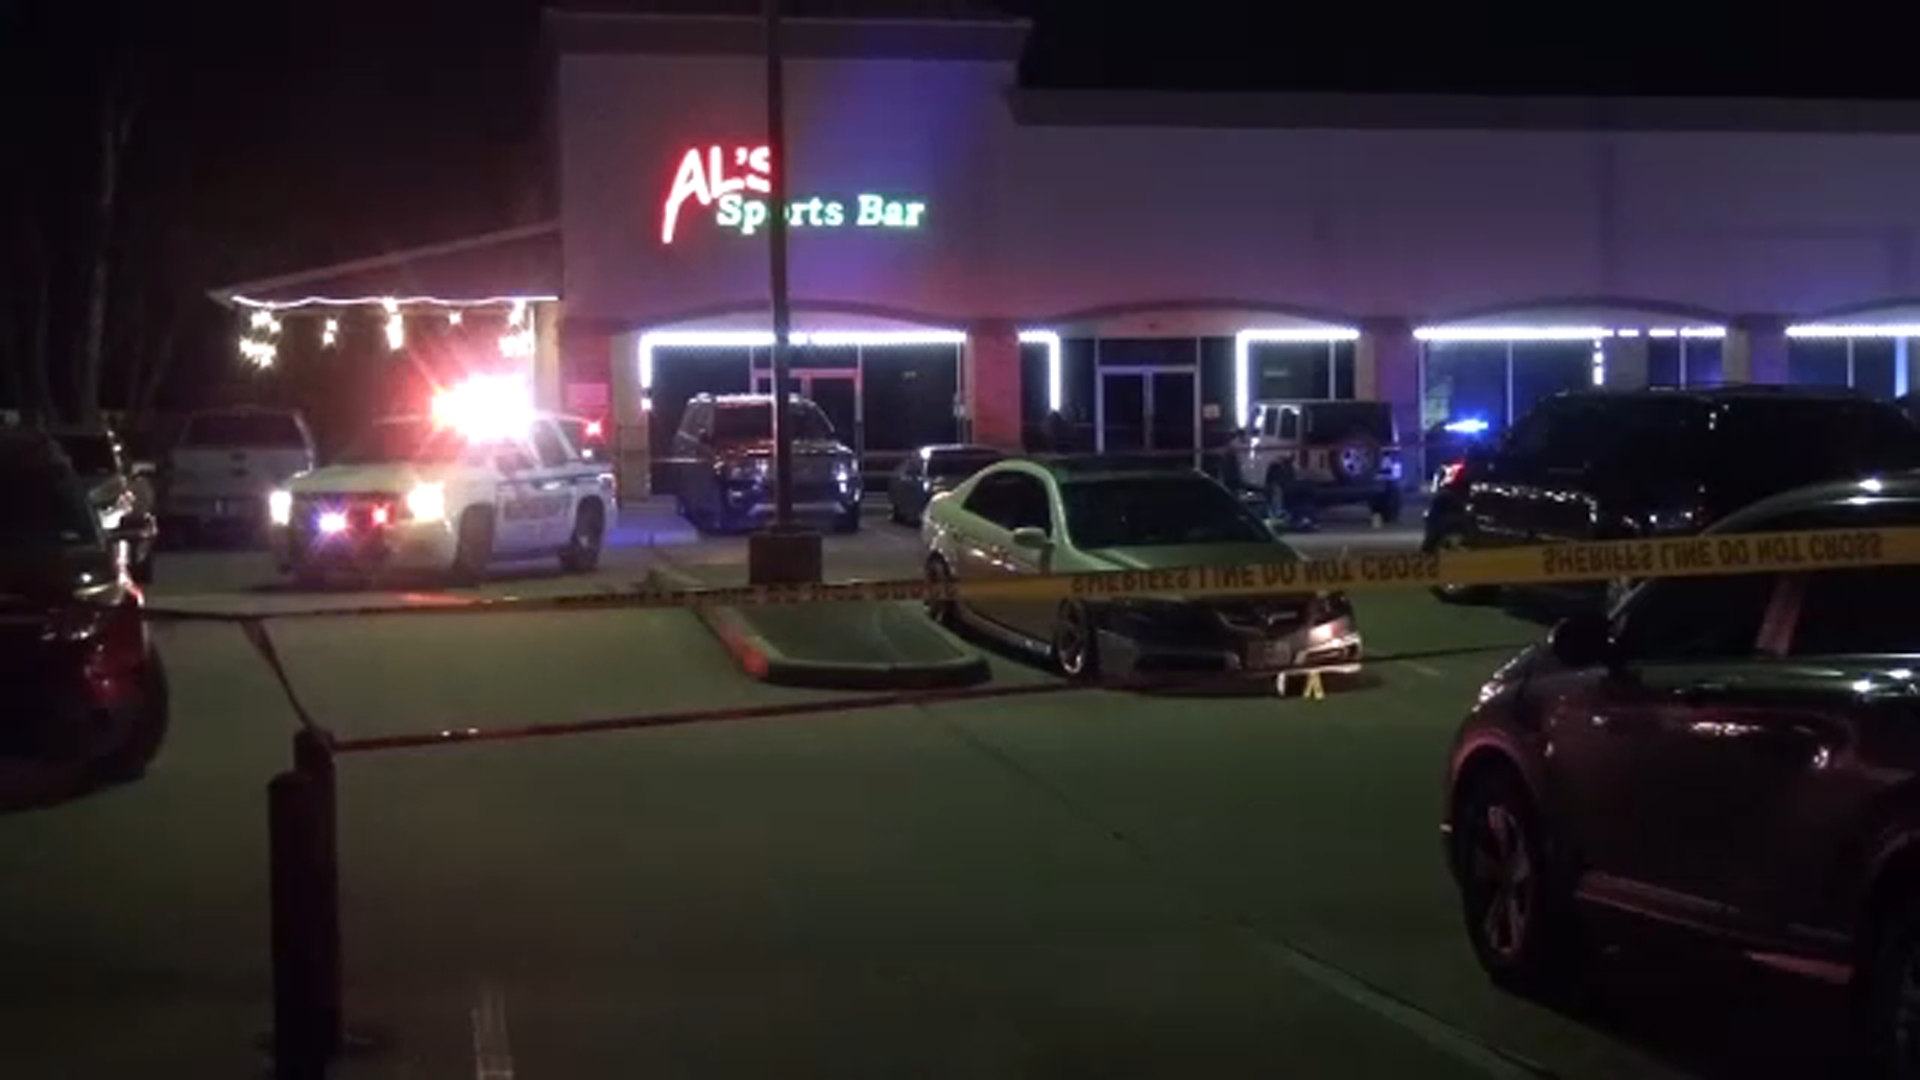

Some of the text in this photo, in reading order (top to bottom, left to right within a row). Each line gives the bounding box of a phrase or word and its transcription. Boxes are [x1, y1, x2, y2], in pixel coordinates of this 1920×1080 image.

[662, 145, 771, 243] AL'S
[716, 193, 925, 235] Sprts Bar
